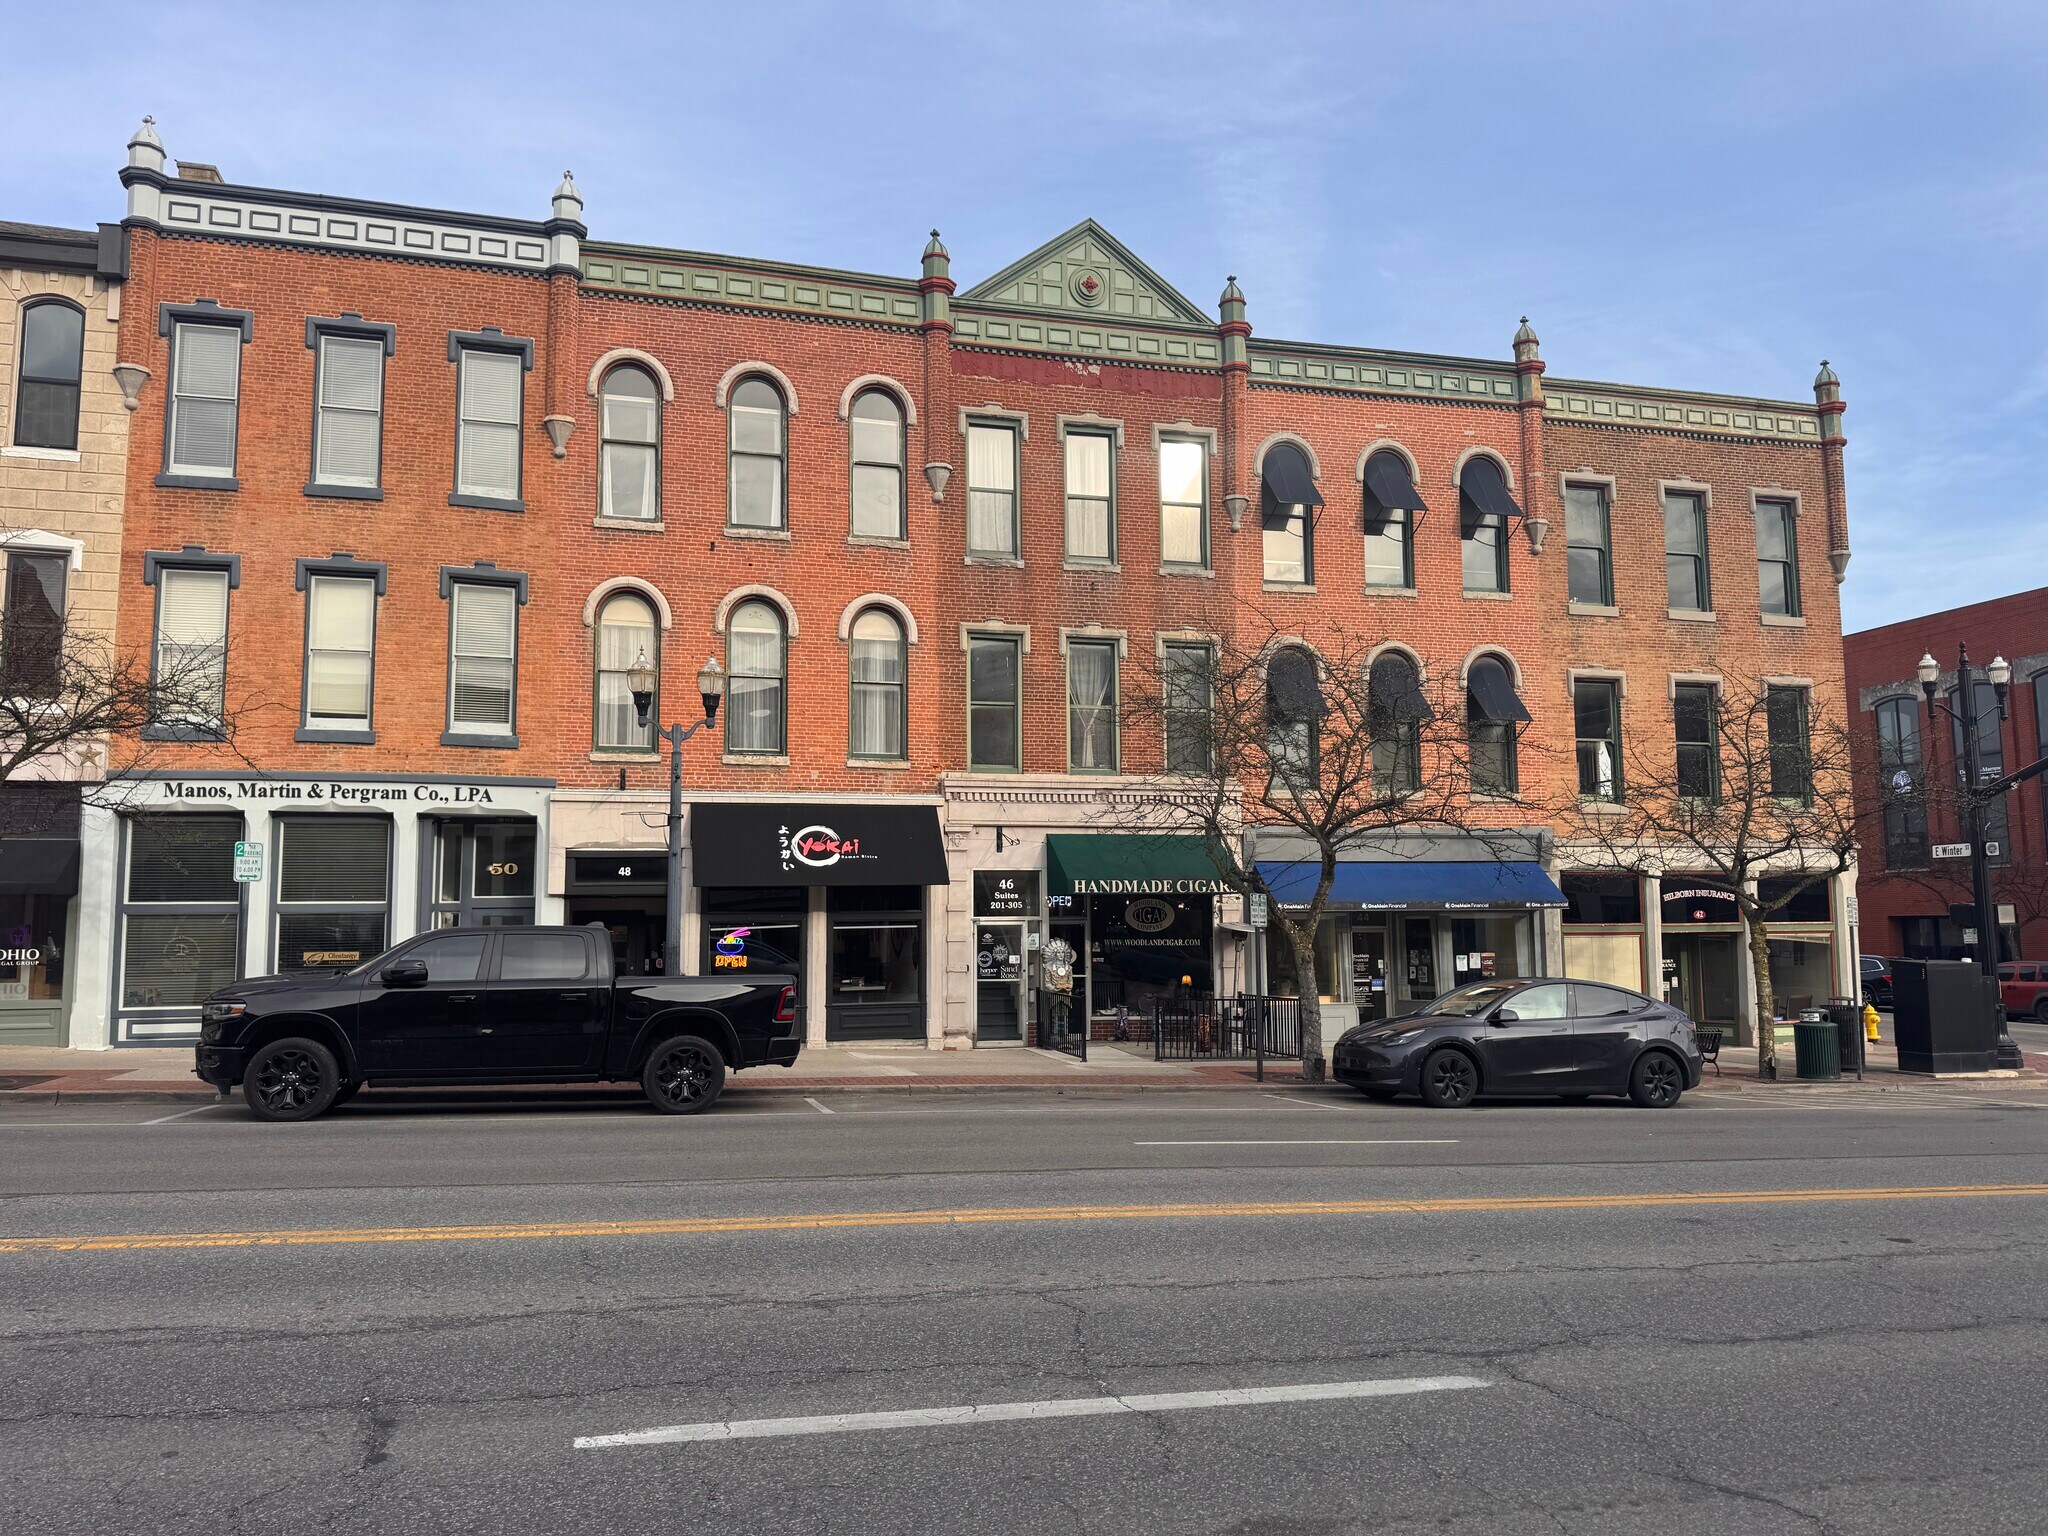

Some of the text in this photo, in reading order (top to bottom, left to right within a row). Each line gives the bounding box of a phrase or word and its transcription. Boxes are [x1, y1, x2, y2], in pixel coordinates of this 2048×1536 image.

[162, 782, 494, 804] Manos, Martin & Pergram Co., LPA
[237, 844, 244, 855] 2
[1935, 846, 1940, 857] E
[1941, 846, 1963, 857] Winter
[491, 862, 519, 875] 50
[618, 866, 632, 876] 48
[999, 879, 1015, 890] 46
[1073, 879, 1173, 894] HANDMADE
[994, 891, 1019, 900] Suites
[1662, 889, 1736, 902] HILBORN INSURANCE
[990, 901, 1023, 909] 201-305
[1133, 900, 1166, 909] WOODLAND
[1133, 908, 1167, 923] CIGAR
[1695, 910, 1704, 918] 42
[1104, 938, 1201, 947] WWW.WOODLANDCIGAR.COM
[0, 948, 40, 961] OHIO
[715, 955, 748, 968] OPEN
